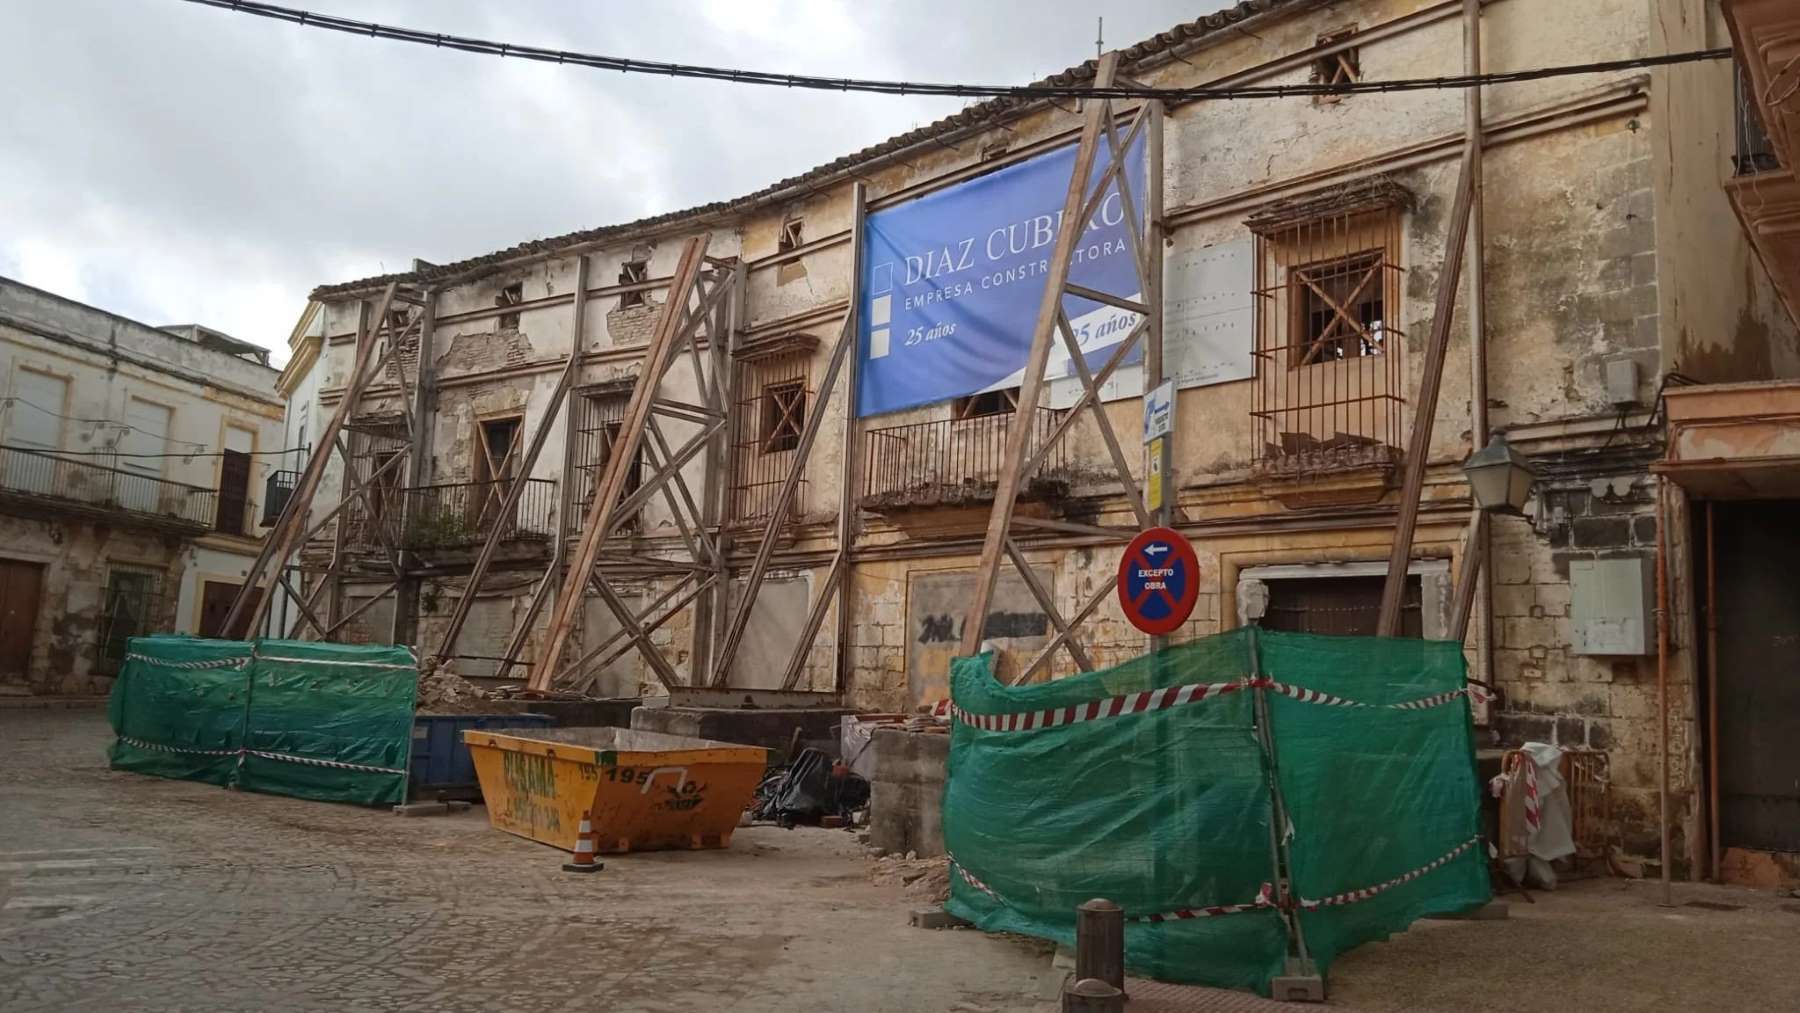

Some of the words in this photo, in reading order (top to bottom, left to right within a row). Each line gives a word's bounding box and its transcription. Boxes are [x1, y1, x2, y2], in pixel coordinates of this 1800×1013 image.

[904, 237, 976, 286] DIAZ
[986, 191, 1125, 262] CUBO
[904, 281, 974, 311] EMPRESA
[981, 238, 1126, 290] CONSTRTORA
[904, 325, 925, 347] 25
[925, 320, 957, 342] años
[1095, 312, 1137, 339] años
[1138, 568, 1174, 578] EXCEPTO
[1144, 581, 1167, 590] OBRA
[605, 764, 650, 786] 195
